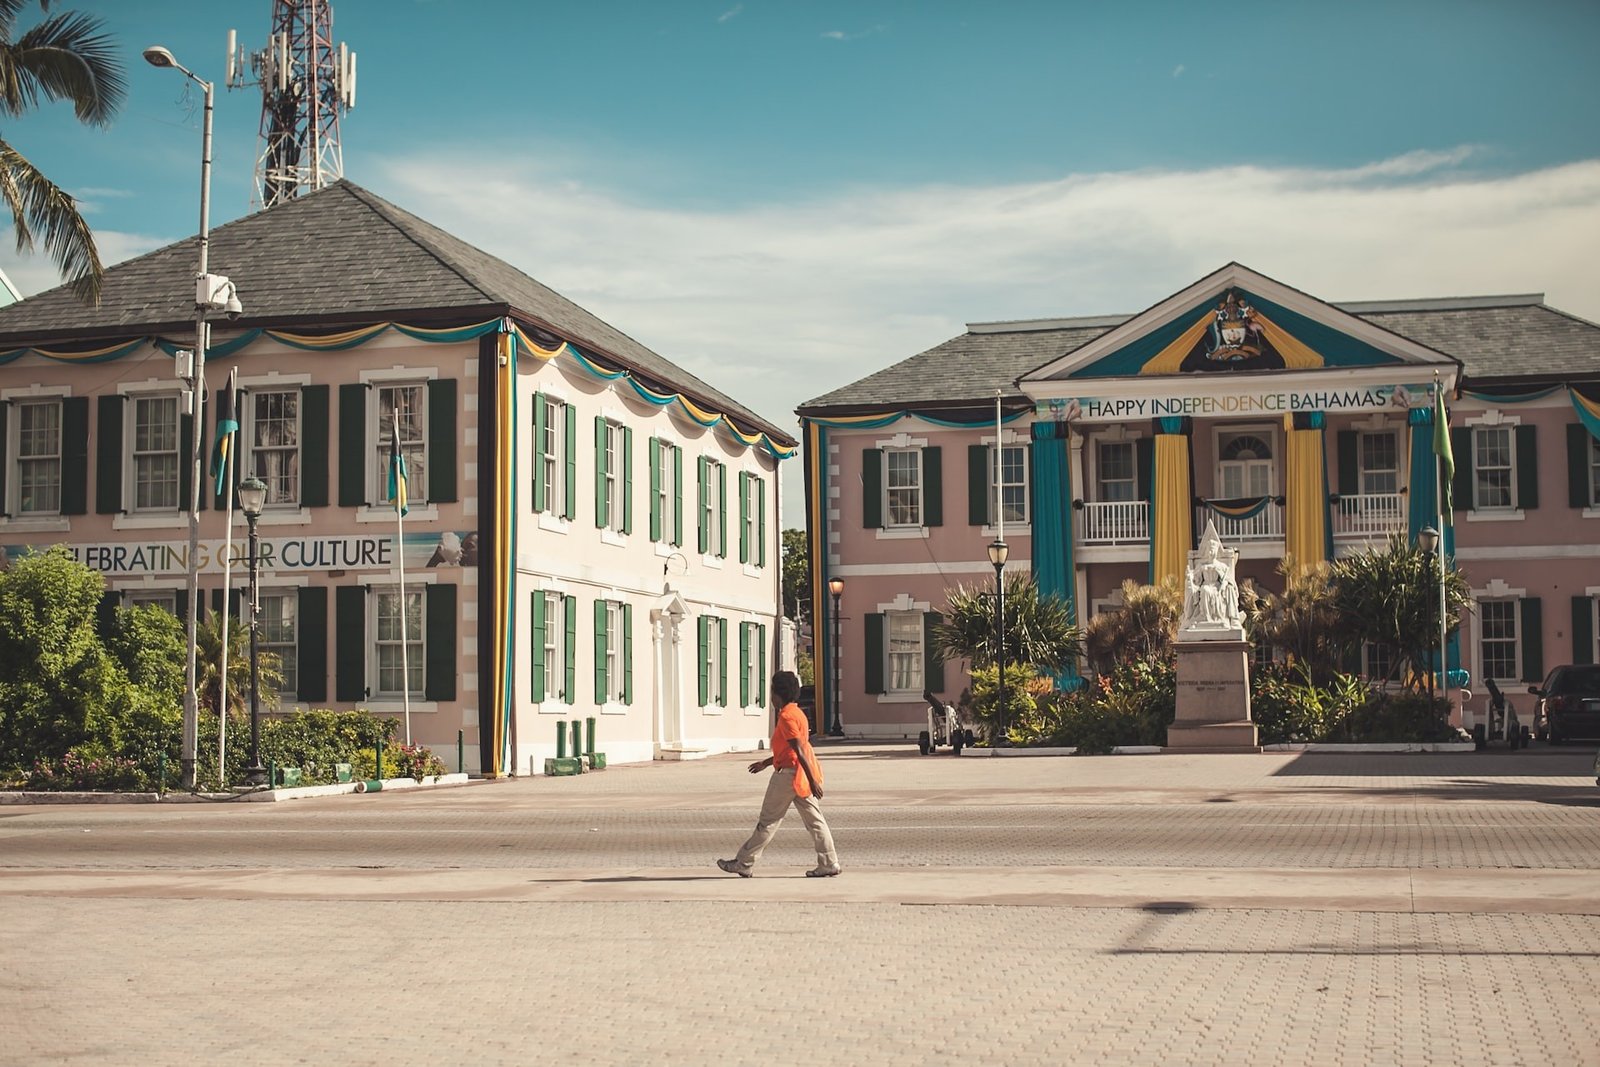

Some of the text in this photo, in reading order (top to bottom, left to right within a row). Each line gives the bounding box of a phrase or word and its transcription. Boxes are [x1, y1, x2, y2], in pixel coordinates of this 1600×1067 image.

[1088, 389, 1387, 417] HAPPY INDEPENDENCE BAHAMAS
[216, 542, 275, 569] OUR
[281, 538, 392, 568] CULTURE
